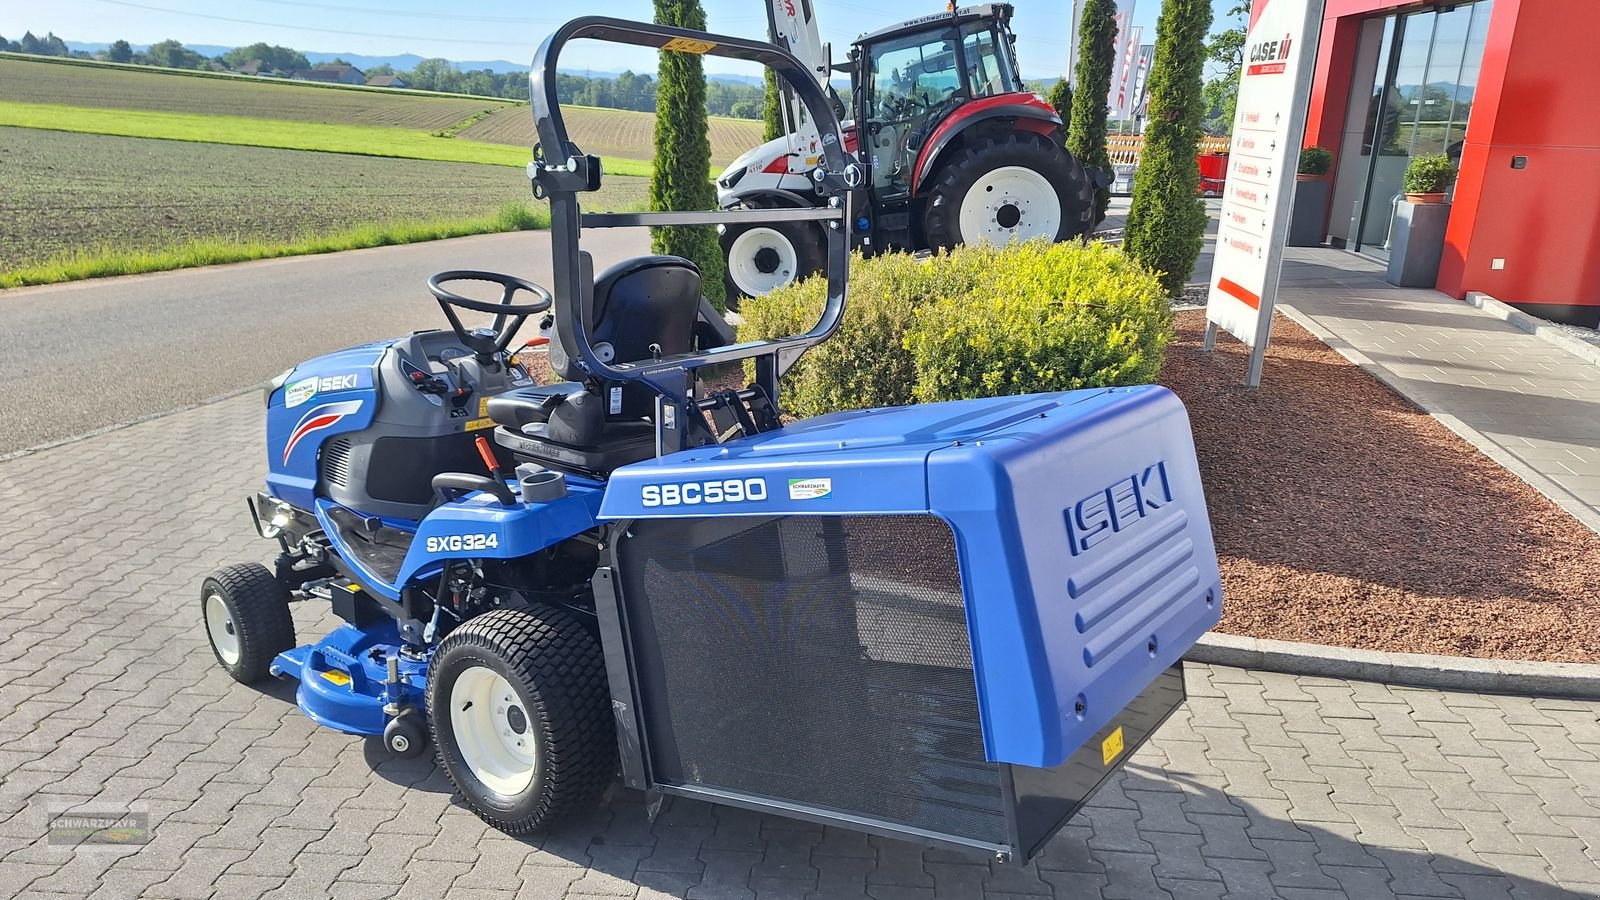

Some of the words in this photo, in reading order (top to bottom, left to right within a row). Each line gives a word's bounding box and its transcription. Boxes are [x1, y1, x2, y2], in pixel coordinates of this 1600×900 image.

[903, 8, 970, 27] www.schwarzmr.at
[1250, 41, 1277, 62] CASE
[318, 373, 358, 392] ISEKI
[641, 477, 767, 507] SBC590
[1062, 460, 1175, 557] ISEKI
[426, 532, 499, 553] SXG324
